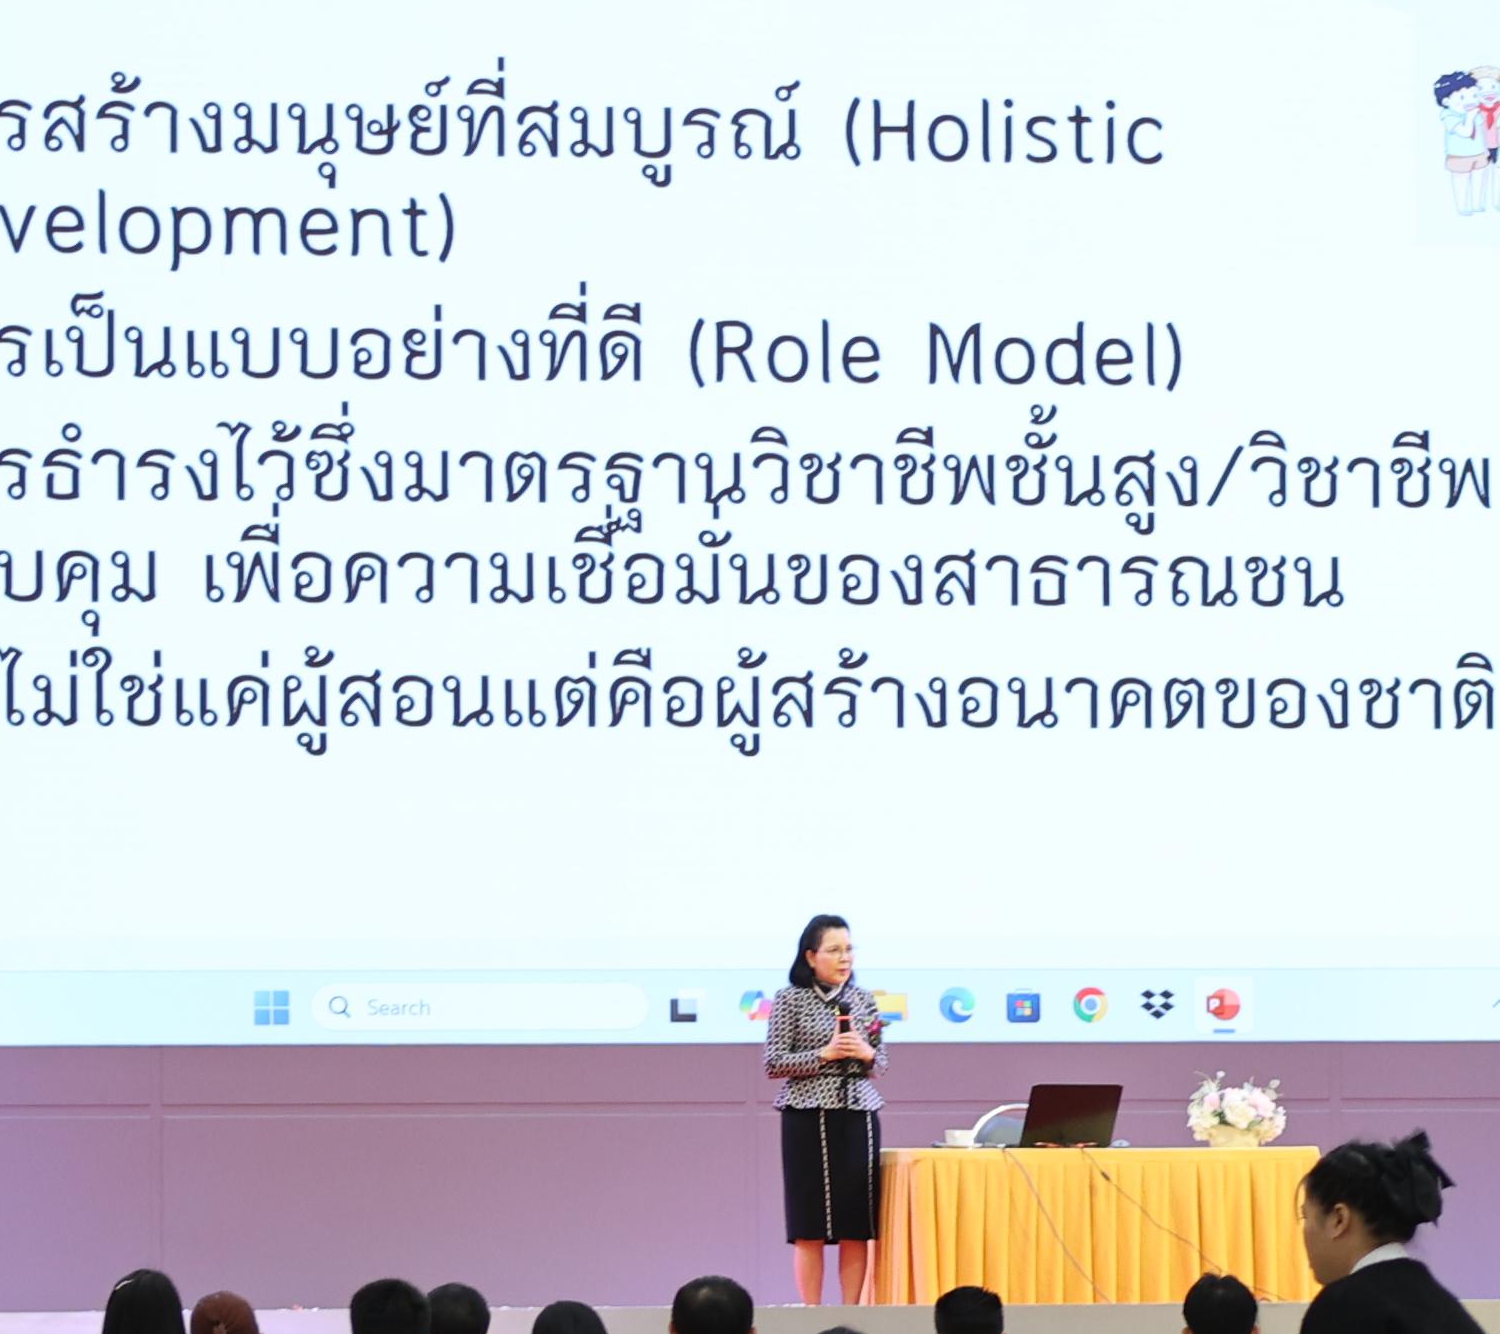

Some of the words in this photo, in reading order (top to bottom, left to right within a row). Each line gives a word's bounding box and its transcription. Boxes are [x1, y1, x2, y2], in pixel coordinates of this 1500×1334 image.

[844, 95, 1164, 168] (Holistic
[688, 317, 882, 389] (Role
[927, 320, 1184, 393] Model)
[204, 504, 1347, 609] เพื่อความเชื่อมั่นของสาธารณชน
[366, 997, 431, 1018] Search
